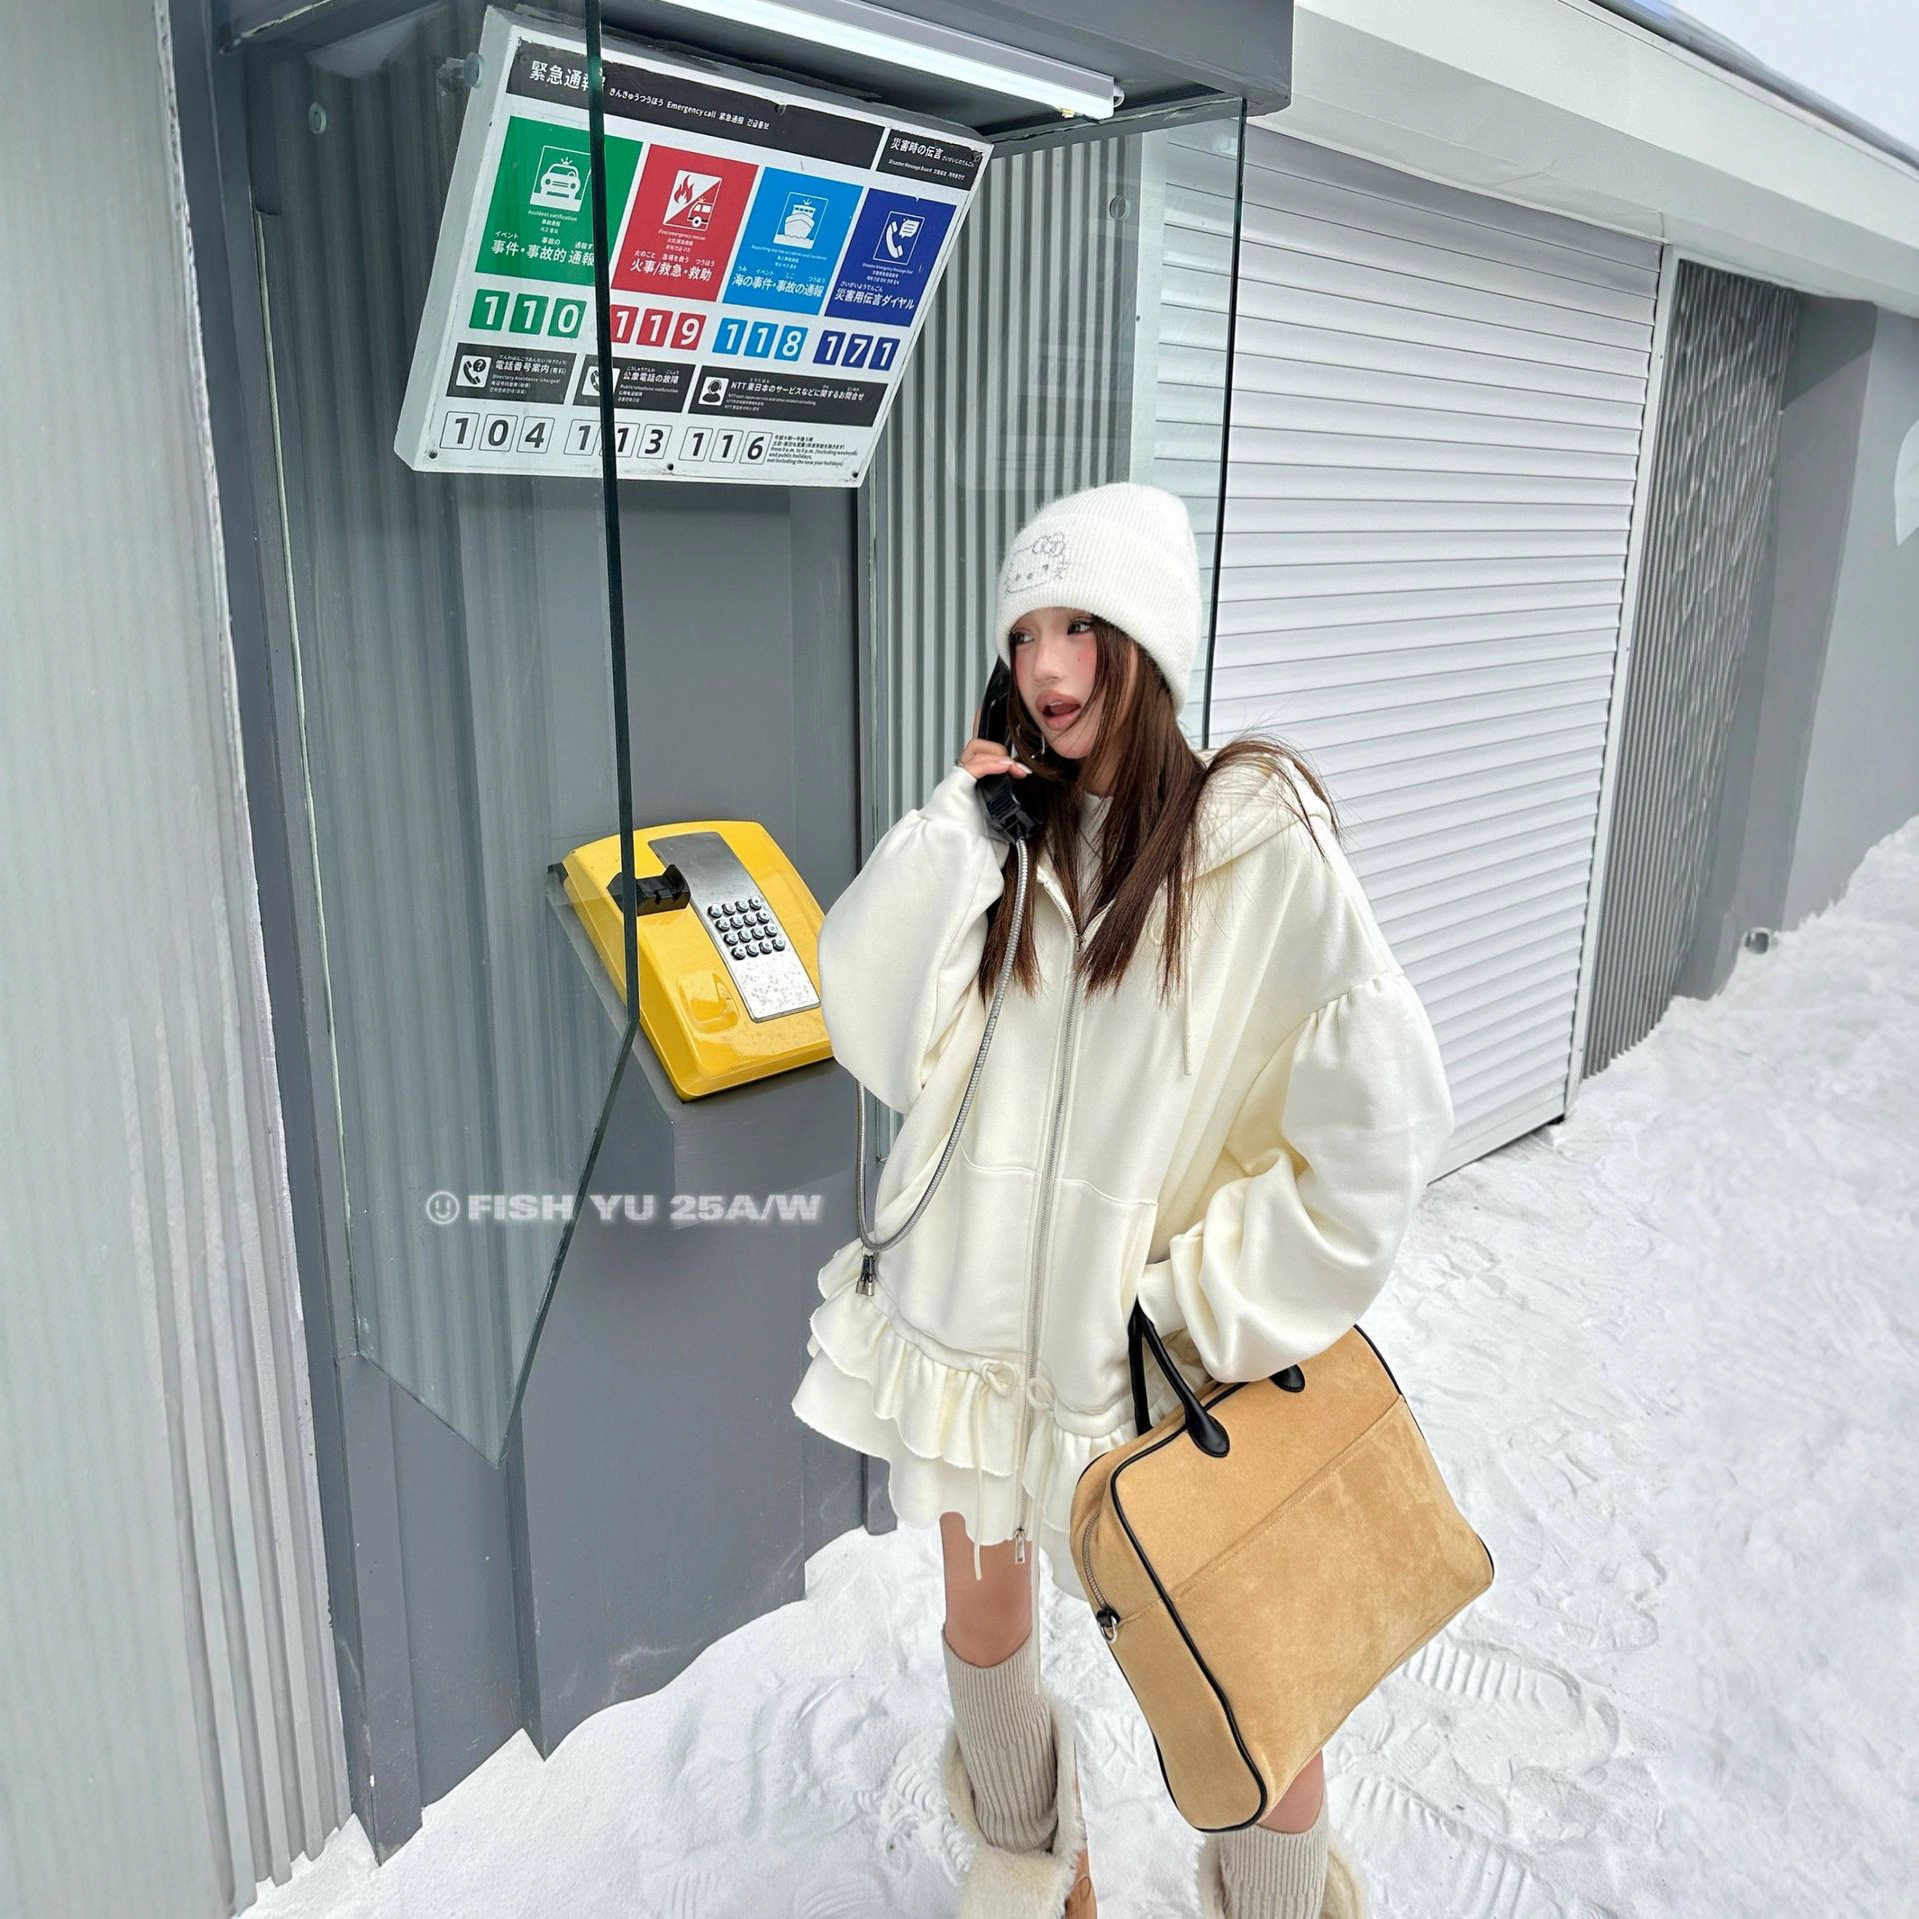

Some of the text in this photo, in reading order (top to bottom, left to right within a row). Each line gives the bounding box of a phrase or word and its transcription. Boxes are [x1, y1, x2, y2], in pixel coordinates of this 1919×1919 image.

[667, 101, 704, 116] Emergency
[704, 110, 717, 119] call
[890, 137, 944, 160] 災害時の伝言
[550, 213, 578, 222] notification
[495, 230, 519, 240] イベント
[630, 258, 713, 282] 火事/救急・救助
[732, 273, 825, 298] 海の事件・事故の通報
[834, 288, 915, 310] 災害用伝言ダイヤル
[484, 295, 580, 335] 110
[616, 310, 702, 346] 119
[726, 323, 802, 357] 118
[824, 335, 893, 367] 171
[623, 371, 680, 385] 公衆電話の故障
[730, 381, 747, 390] NTT
[747, 382, 865, 401] 東日本のサービスなどに関するお問合せ
[454, 417, 545, 449] 104
[577, 424, 664, 455] 113
[692, 431, 765, 460] 116
